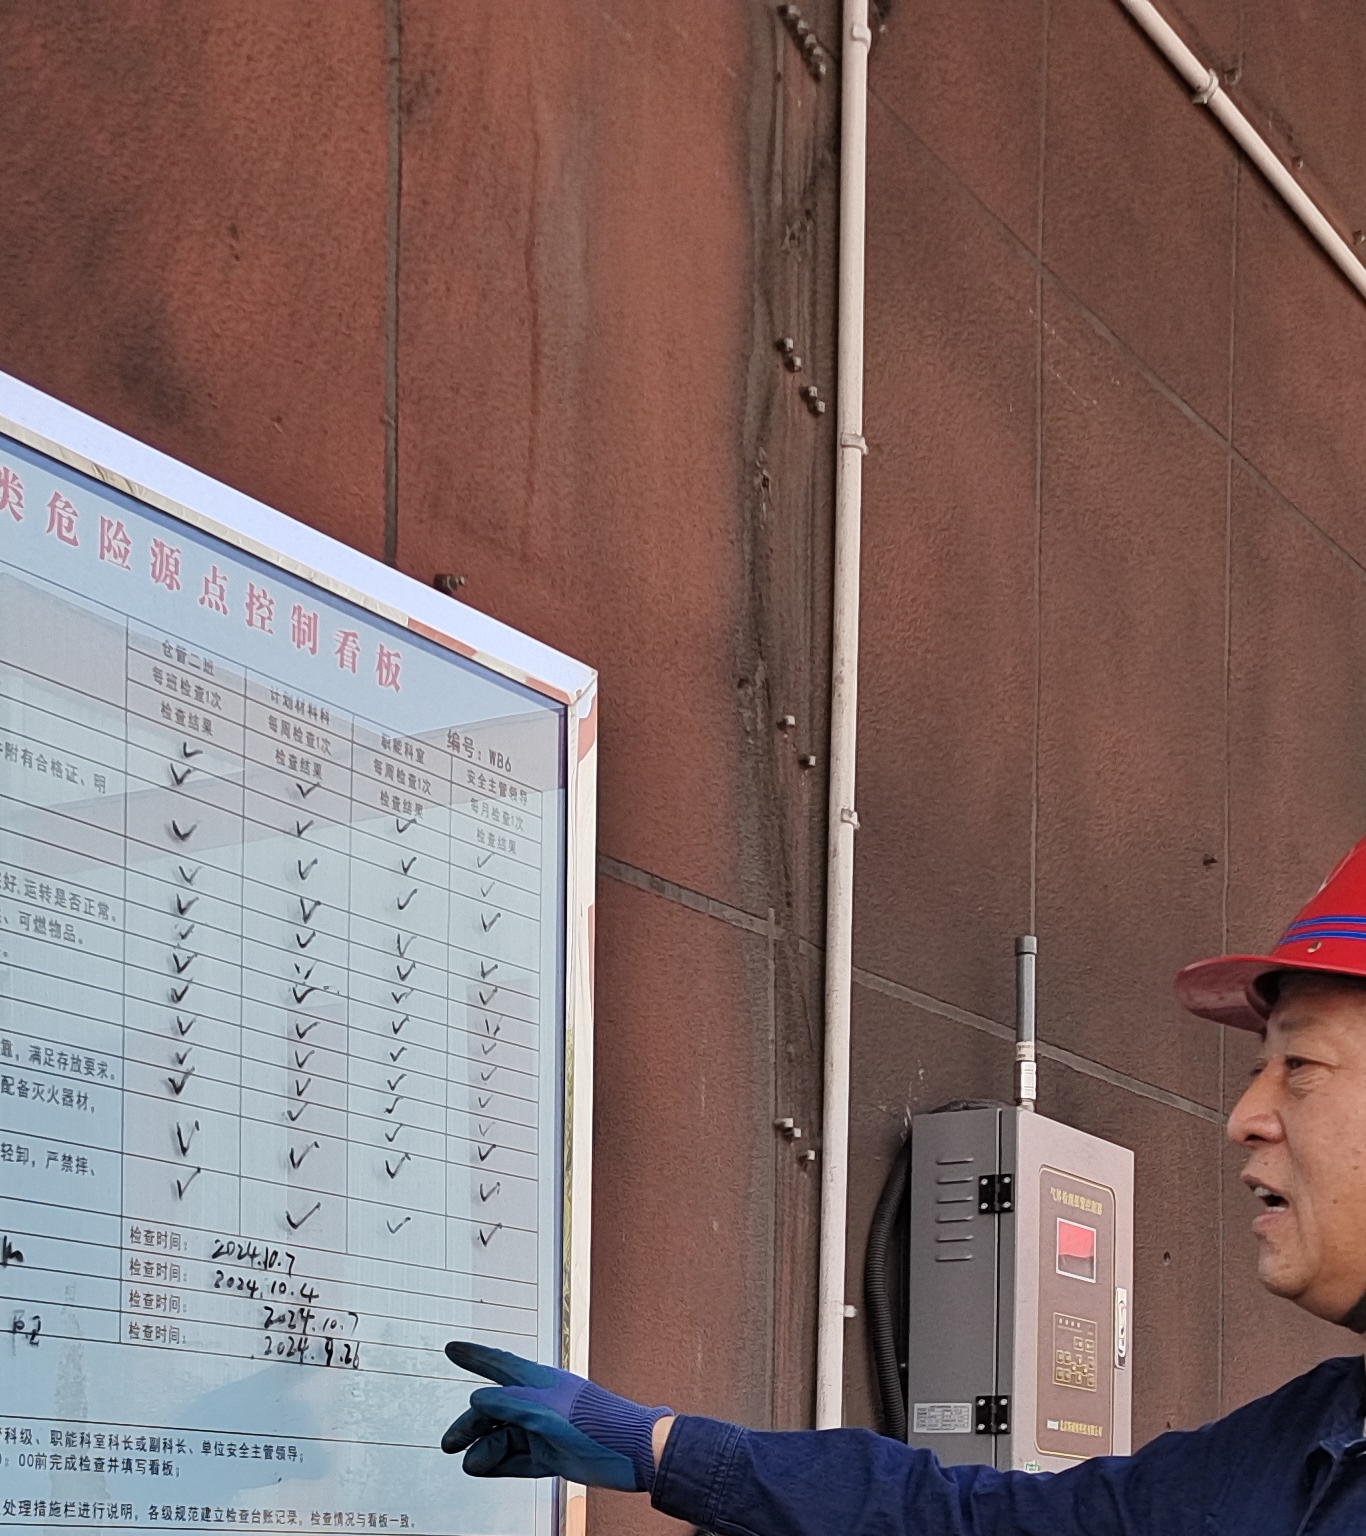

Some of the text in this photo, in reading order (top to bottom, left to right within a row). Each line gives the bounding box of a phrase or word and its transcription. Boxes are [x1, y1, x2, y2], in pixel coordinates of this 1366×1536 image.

[160, 702, 214, 737] 检查结果
[275, 748, 323, 780] 检查结果
